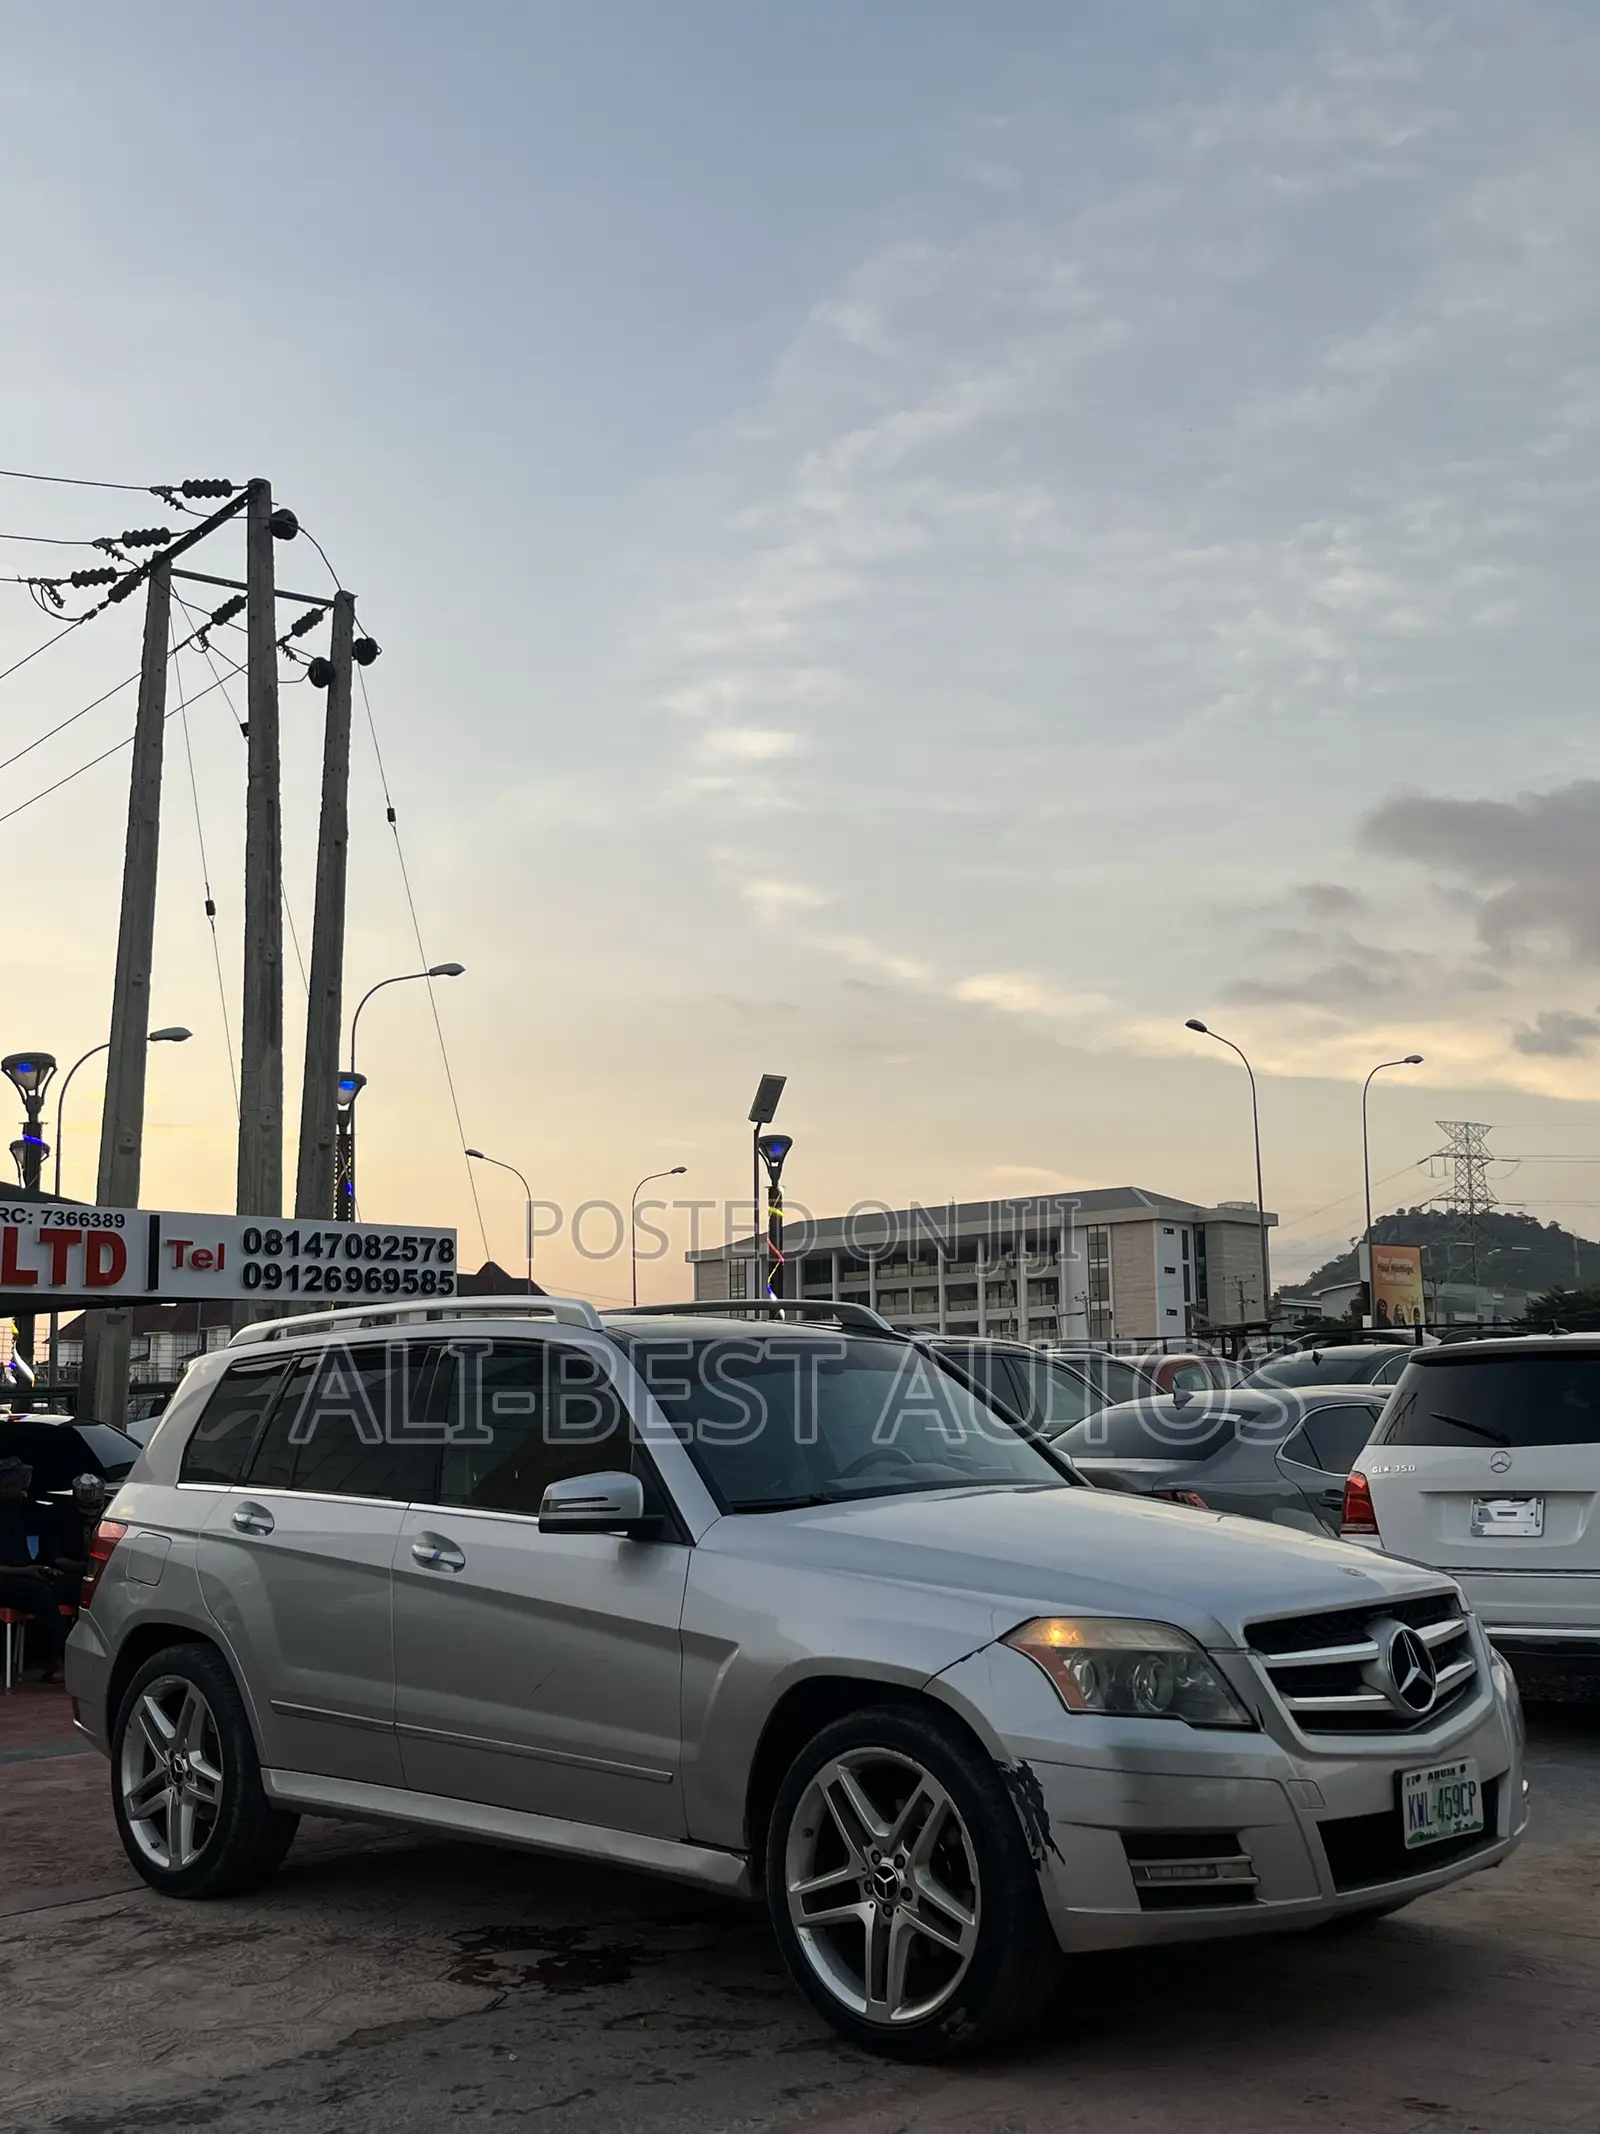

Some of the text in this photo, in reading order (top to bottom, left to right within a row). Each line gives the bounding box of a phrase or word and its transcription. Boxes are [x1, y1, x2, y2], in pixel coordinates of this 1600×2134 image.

[41, 1210, 126, 1228] 7366389
[1, 1226, 128, 1288] LTD
[167, 1239, 225, 1271] Tel
[241, 1227, 455, 1264] 08147082578
[241, 1262, 455, 1295] 09126969585
[1372, 1464, 1416, 1474] GLK 350
